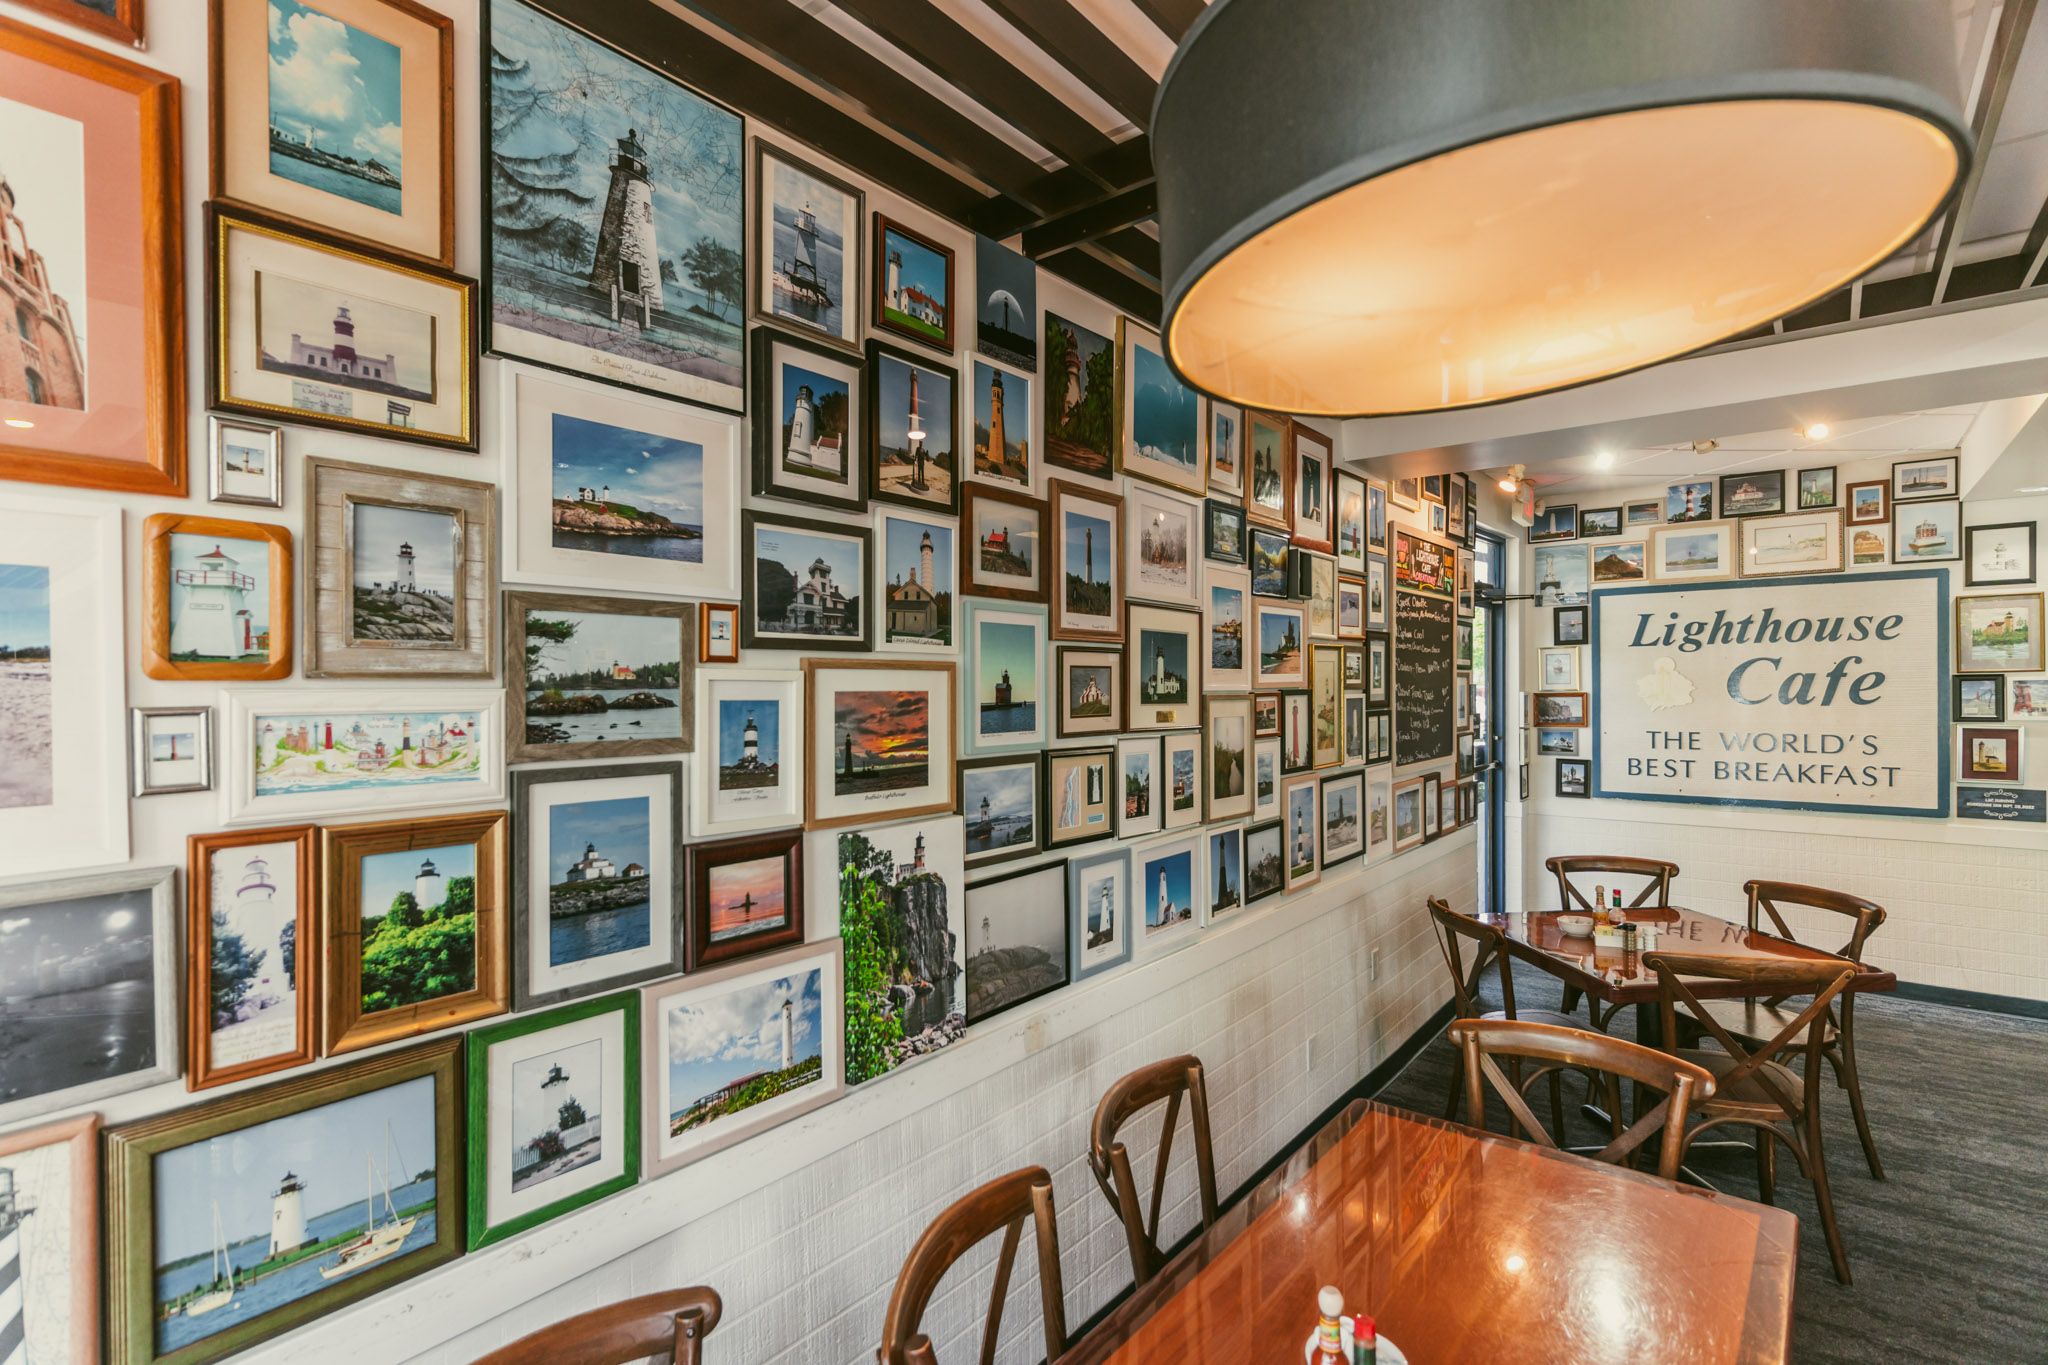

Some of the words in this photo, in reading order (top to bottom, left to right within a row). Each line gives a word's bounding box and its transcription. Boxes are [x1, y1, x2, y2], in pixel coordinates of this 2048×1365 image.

[1415, 548, 1440, 567] LIGHTHOUSE
[1423, 542, 1431, 552] THE
[1421, 563, 1432, 574] CAFE
[1628, 607, 1904, 653] Lighthouse
[1726, 655, 1886, 707] Cafe
[1646, 731, 1701, 750] THE
[1719, 732, 1879, 756] WORLD'S
[1627, 757, 1696, 779] BEST
[1714, 760, 1901, 787] BREAKFAST
